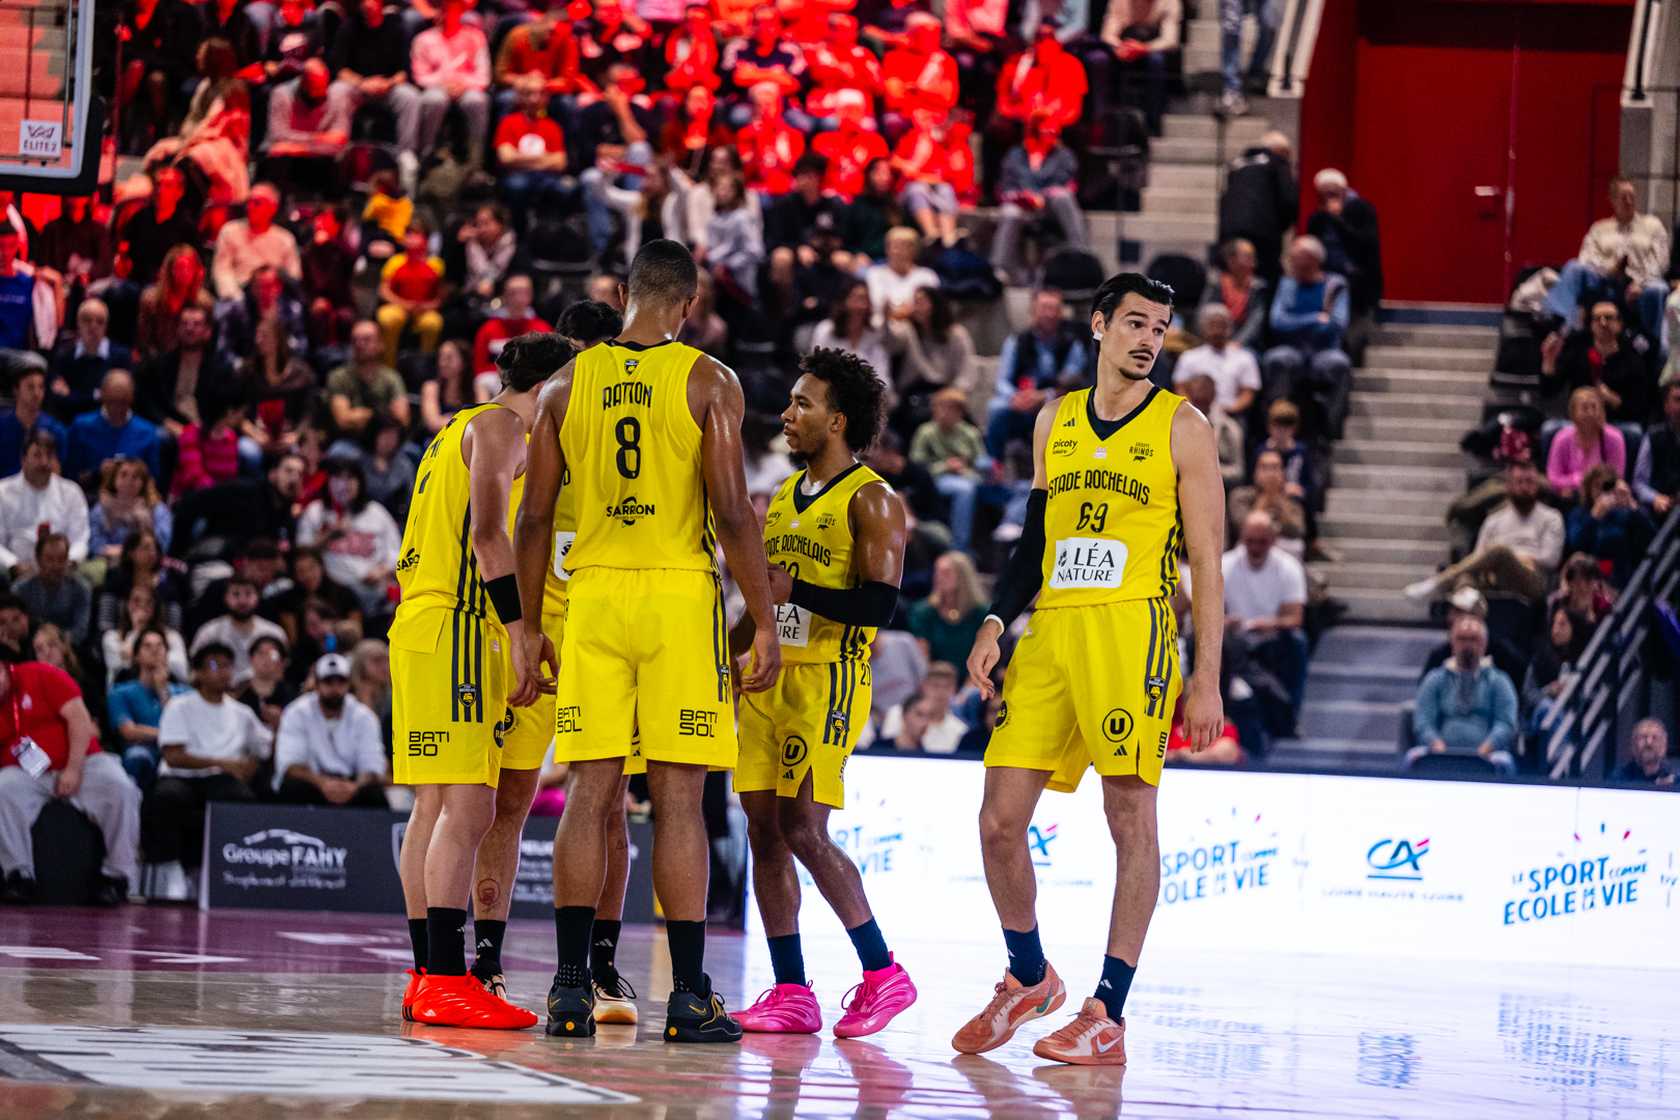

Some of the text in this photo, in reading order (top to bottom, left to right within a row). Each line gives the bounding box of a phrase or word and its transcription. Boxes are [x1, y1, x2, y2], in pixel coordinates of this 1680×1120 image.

[602, 381, 653, 411] RATTON
[615, 416, 641, 480] 8
[1053, 439, 1078, 450] picoty
[1129, 446, 1154, 458] RHINOS
[1048, 468, 1151, 505] STADE ROCHELAIS
[606, 504, 655, 517] SARRON
[1076, 501, 1108, 533] 69
[781, 534, 831, 567] ROCHELAIS
[1073, 542, 1115, 568] LÉA
[1057, 567, 1115, 583] NATURE
[558, 706, 581, 719] BATI
[680, 709, 718, 724] BATI
[408, 731, 450, 743] BATI
[557, 718, 583, 734] SOL
[679, 722, 715, 738] SOL
[1110, 717, 1126, 735] U
[784, 743, 801, 760] U
[222, 842, 347, 869] Groupe FAHY
[1162, 839, 1240, 878] SPORT
[1164, 874, 1208, 905] OLE
[1233, 862, 1270, 890] VIE
[1528, 855, 1609, 893] SPORT
[1503, 890, 1577, 926] ECOLE
[1602, 879, 1638, 907] VIE
